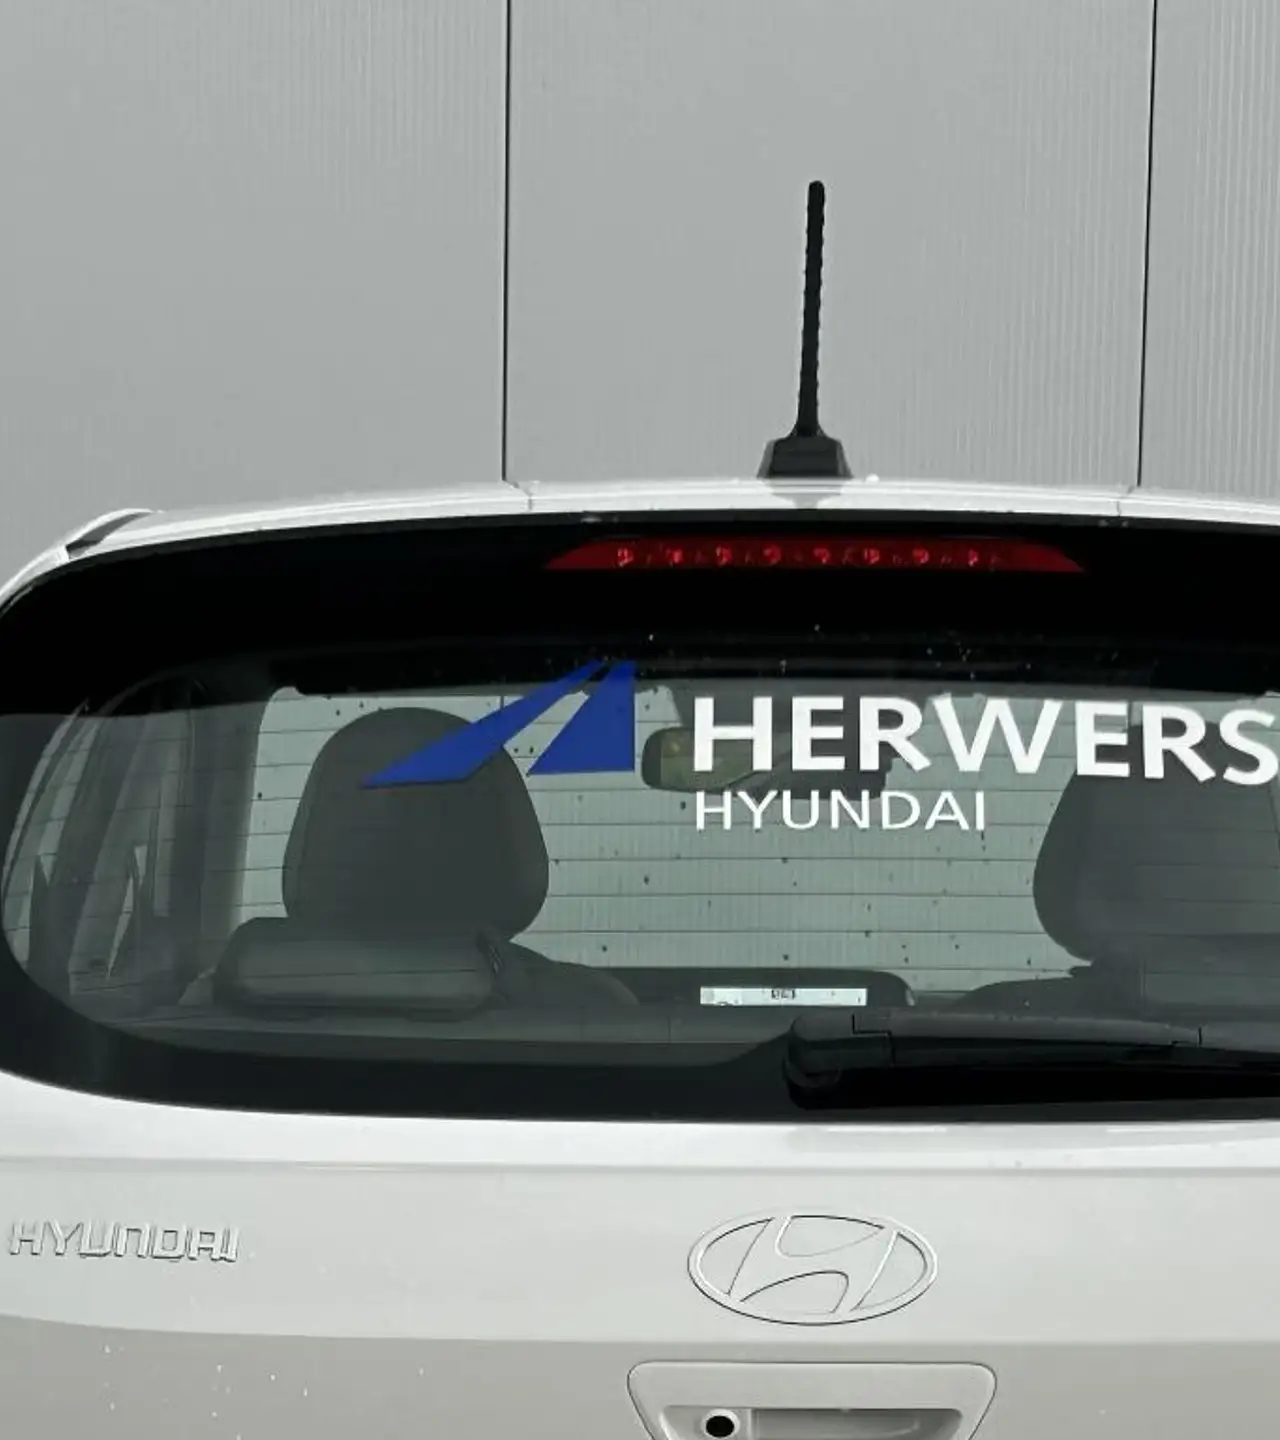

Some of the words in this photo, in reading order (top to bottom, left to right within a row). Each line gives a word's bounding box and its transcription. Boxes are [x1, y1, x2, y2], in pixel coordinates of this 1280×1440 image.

[693, 696, 1280, 785] HERWERS
[696, 790, 986, 831] HYUNDAI
[9, 1219, 239, 1263] HYUNDAI
